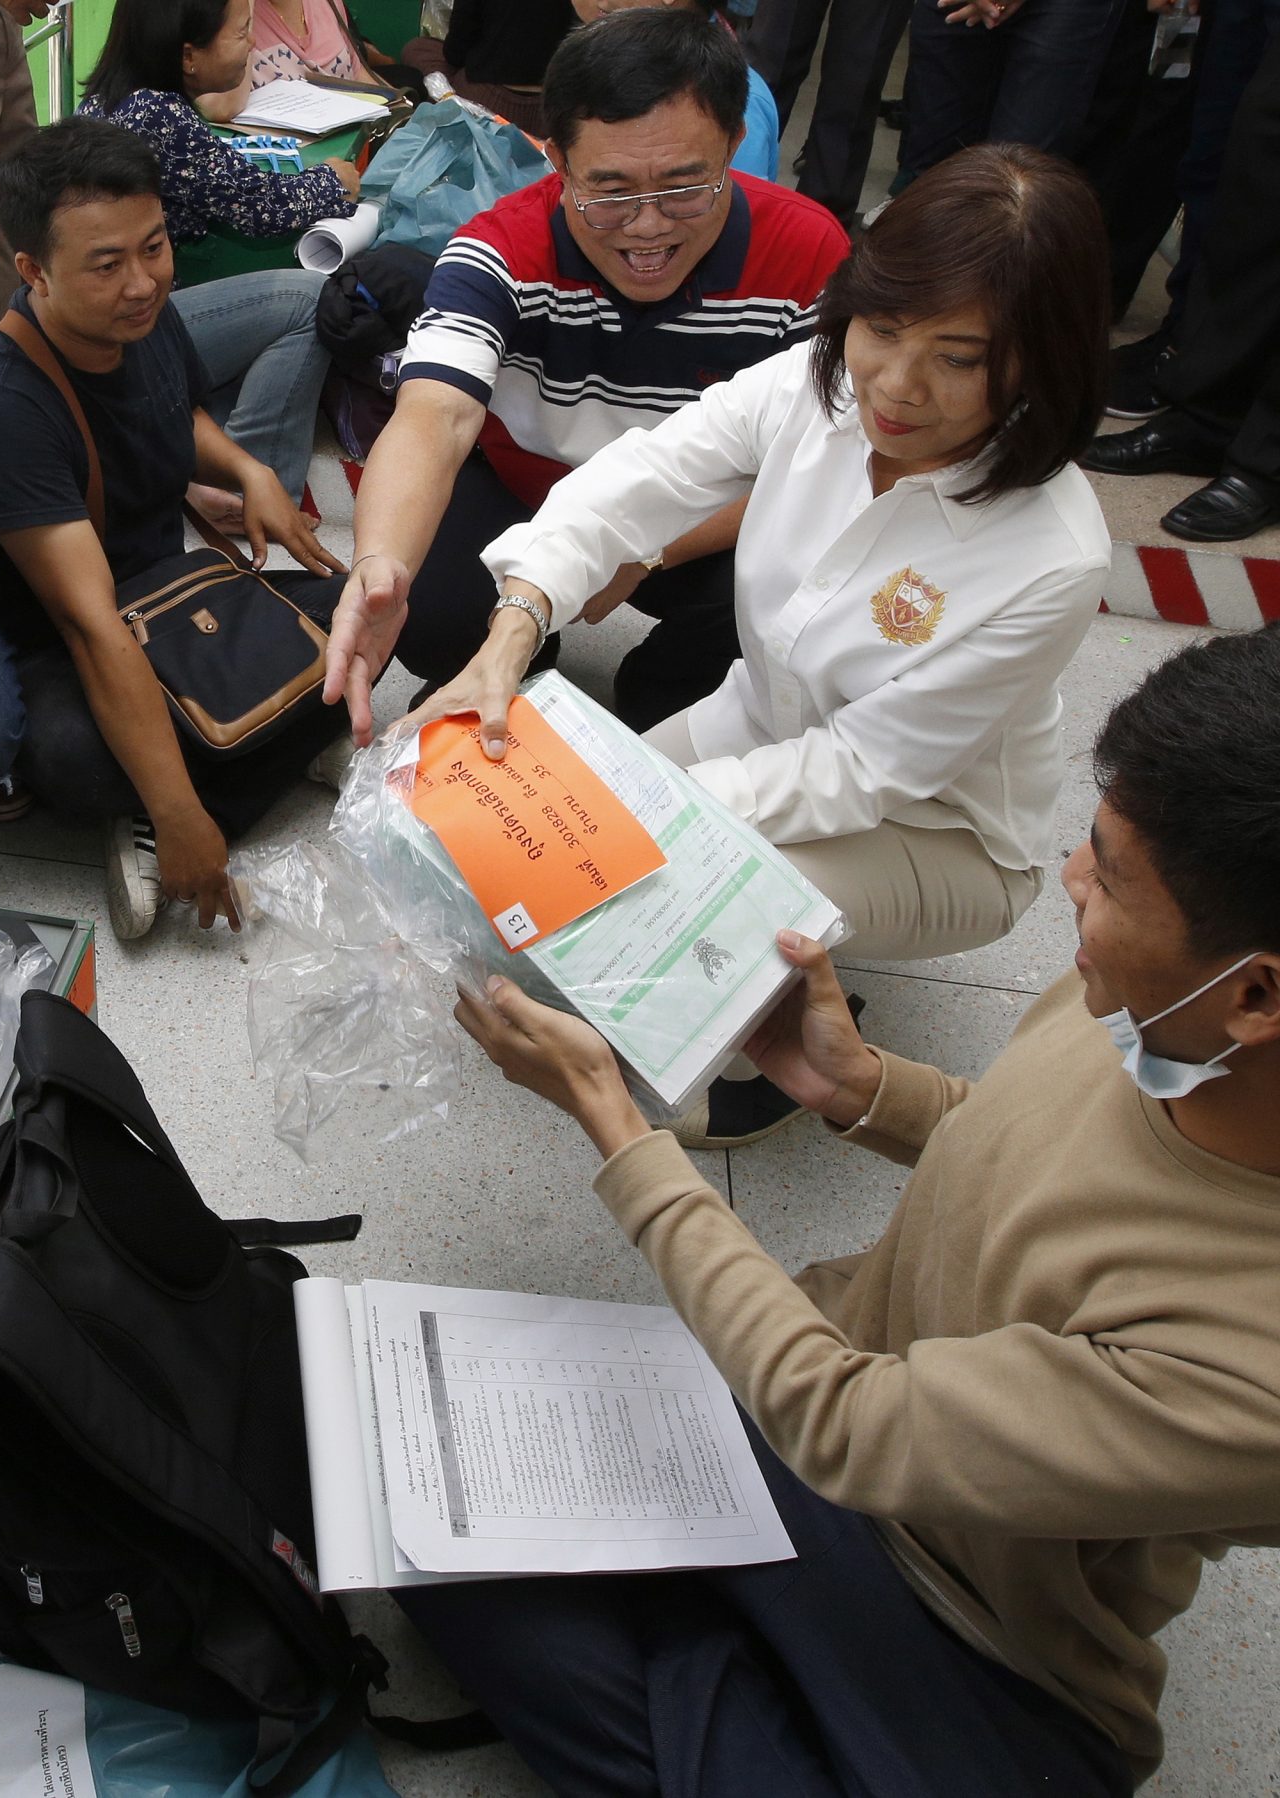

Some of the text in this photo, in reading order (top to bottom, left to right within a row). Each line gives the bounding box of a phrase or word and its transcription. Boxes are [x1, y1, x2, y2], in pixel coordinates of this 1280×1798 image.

[531, 764, 551, 778] 35
[445, 760, 543, 861] ถุงบัตรเลือกตั้ง
[541, 806, 580, 849] 301828
[563, 794, 598, 836] จำนวน
[508, 913, 528, 935] 13
